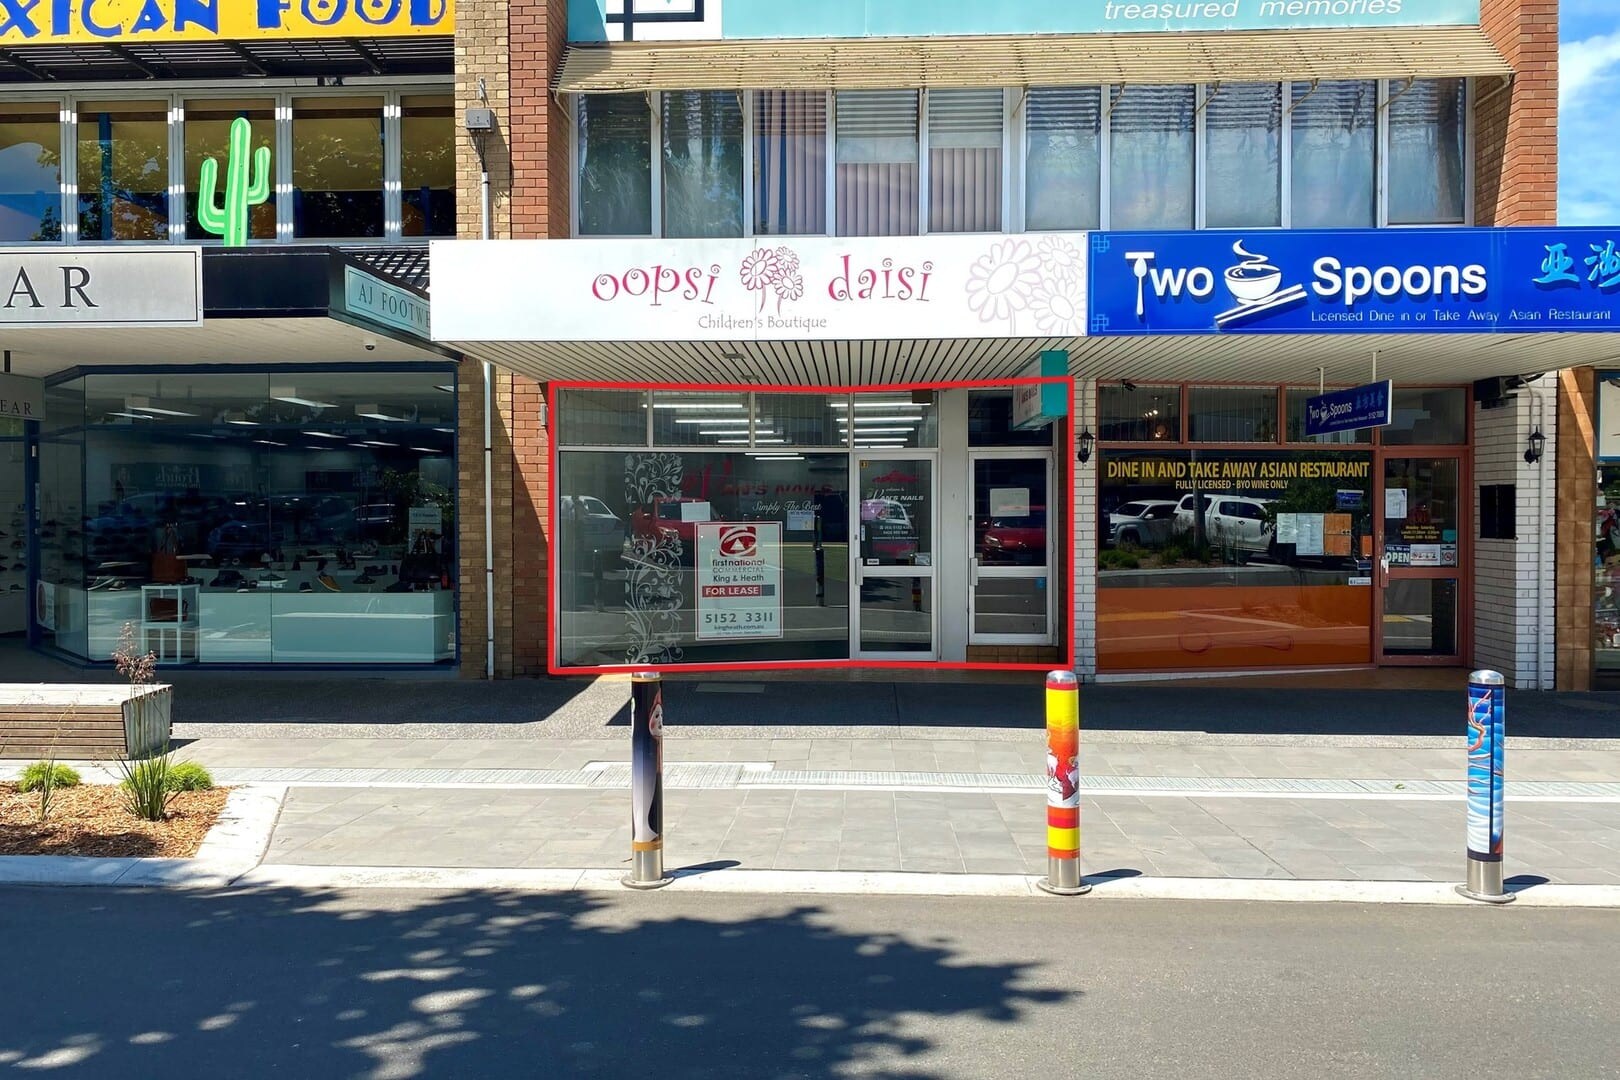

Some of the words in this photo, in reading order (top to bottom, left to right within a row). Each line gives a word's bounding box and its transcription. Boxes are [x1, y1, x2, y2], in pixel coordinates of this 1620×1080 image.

[1104, 0, 1239, 20] treasured
[1258, 0, 1400, 17] memories
[5, 266, 99, 309] AR
[592, 263, 722, 306] oopsi
[828, 254, 933, 302] daisi
[1125, 251, 1214, 316] Two
[1312, 256, 1487, 305] Spoons
[359, 283, 373, 305] AJ
[698, 314, 763, 331] Children's
[767, 315, 827, 333] Boutique
[1311, 310, 1363, 322] Licensed
[1369, 309, 1395, 321] Dine
[1415, 311, 1426, 321] or
[1432, 309, 1461, 321] Take
[1467, 309, 1500, 323] Away
[1508, 309, 1542, 320] Asian
[1548, 308, 1611, 320] Restaurant
[1329, 402, 1352, 418] Spoons
[1107, 461, 1139, 478] DINE
[1141, 461, 1155, 478] IN
[1158, 461, 1186, 478] AND
[1188, 461, 1220, 478] TAKE
[1222, 462, 1257, 478] AWAY
[1260, 462, 1297, 478] ASIAN
[1300, 462, 1370, 478] RESTAURANT
[1175, 480, 1197, 490] FULLY
[1197, 480, 1231, 489] LICENSED
[1236, 480, 1250, 489] BYO
[1251, 480, 1270, 489] WINE
[1271, 480, 1288, 489] ONLY
[752, 501, 781, 515] Simply
[783, 501, 801, 511] The
[801, 501, 822, 511] Best
[1386, 552, 1410, 562] OPEN
[713, 574, 731, 583] King
[728, 587, 759, 595] LEASE
[705, 613, 737, 623] 5152
[745, 612, 773, 622] 3311
